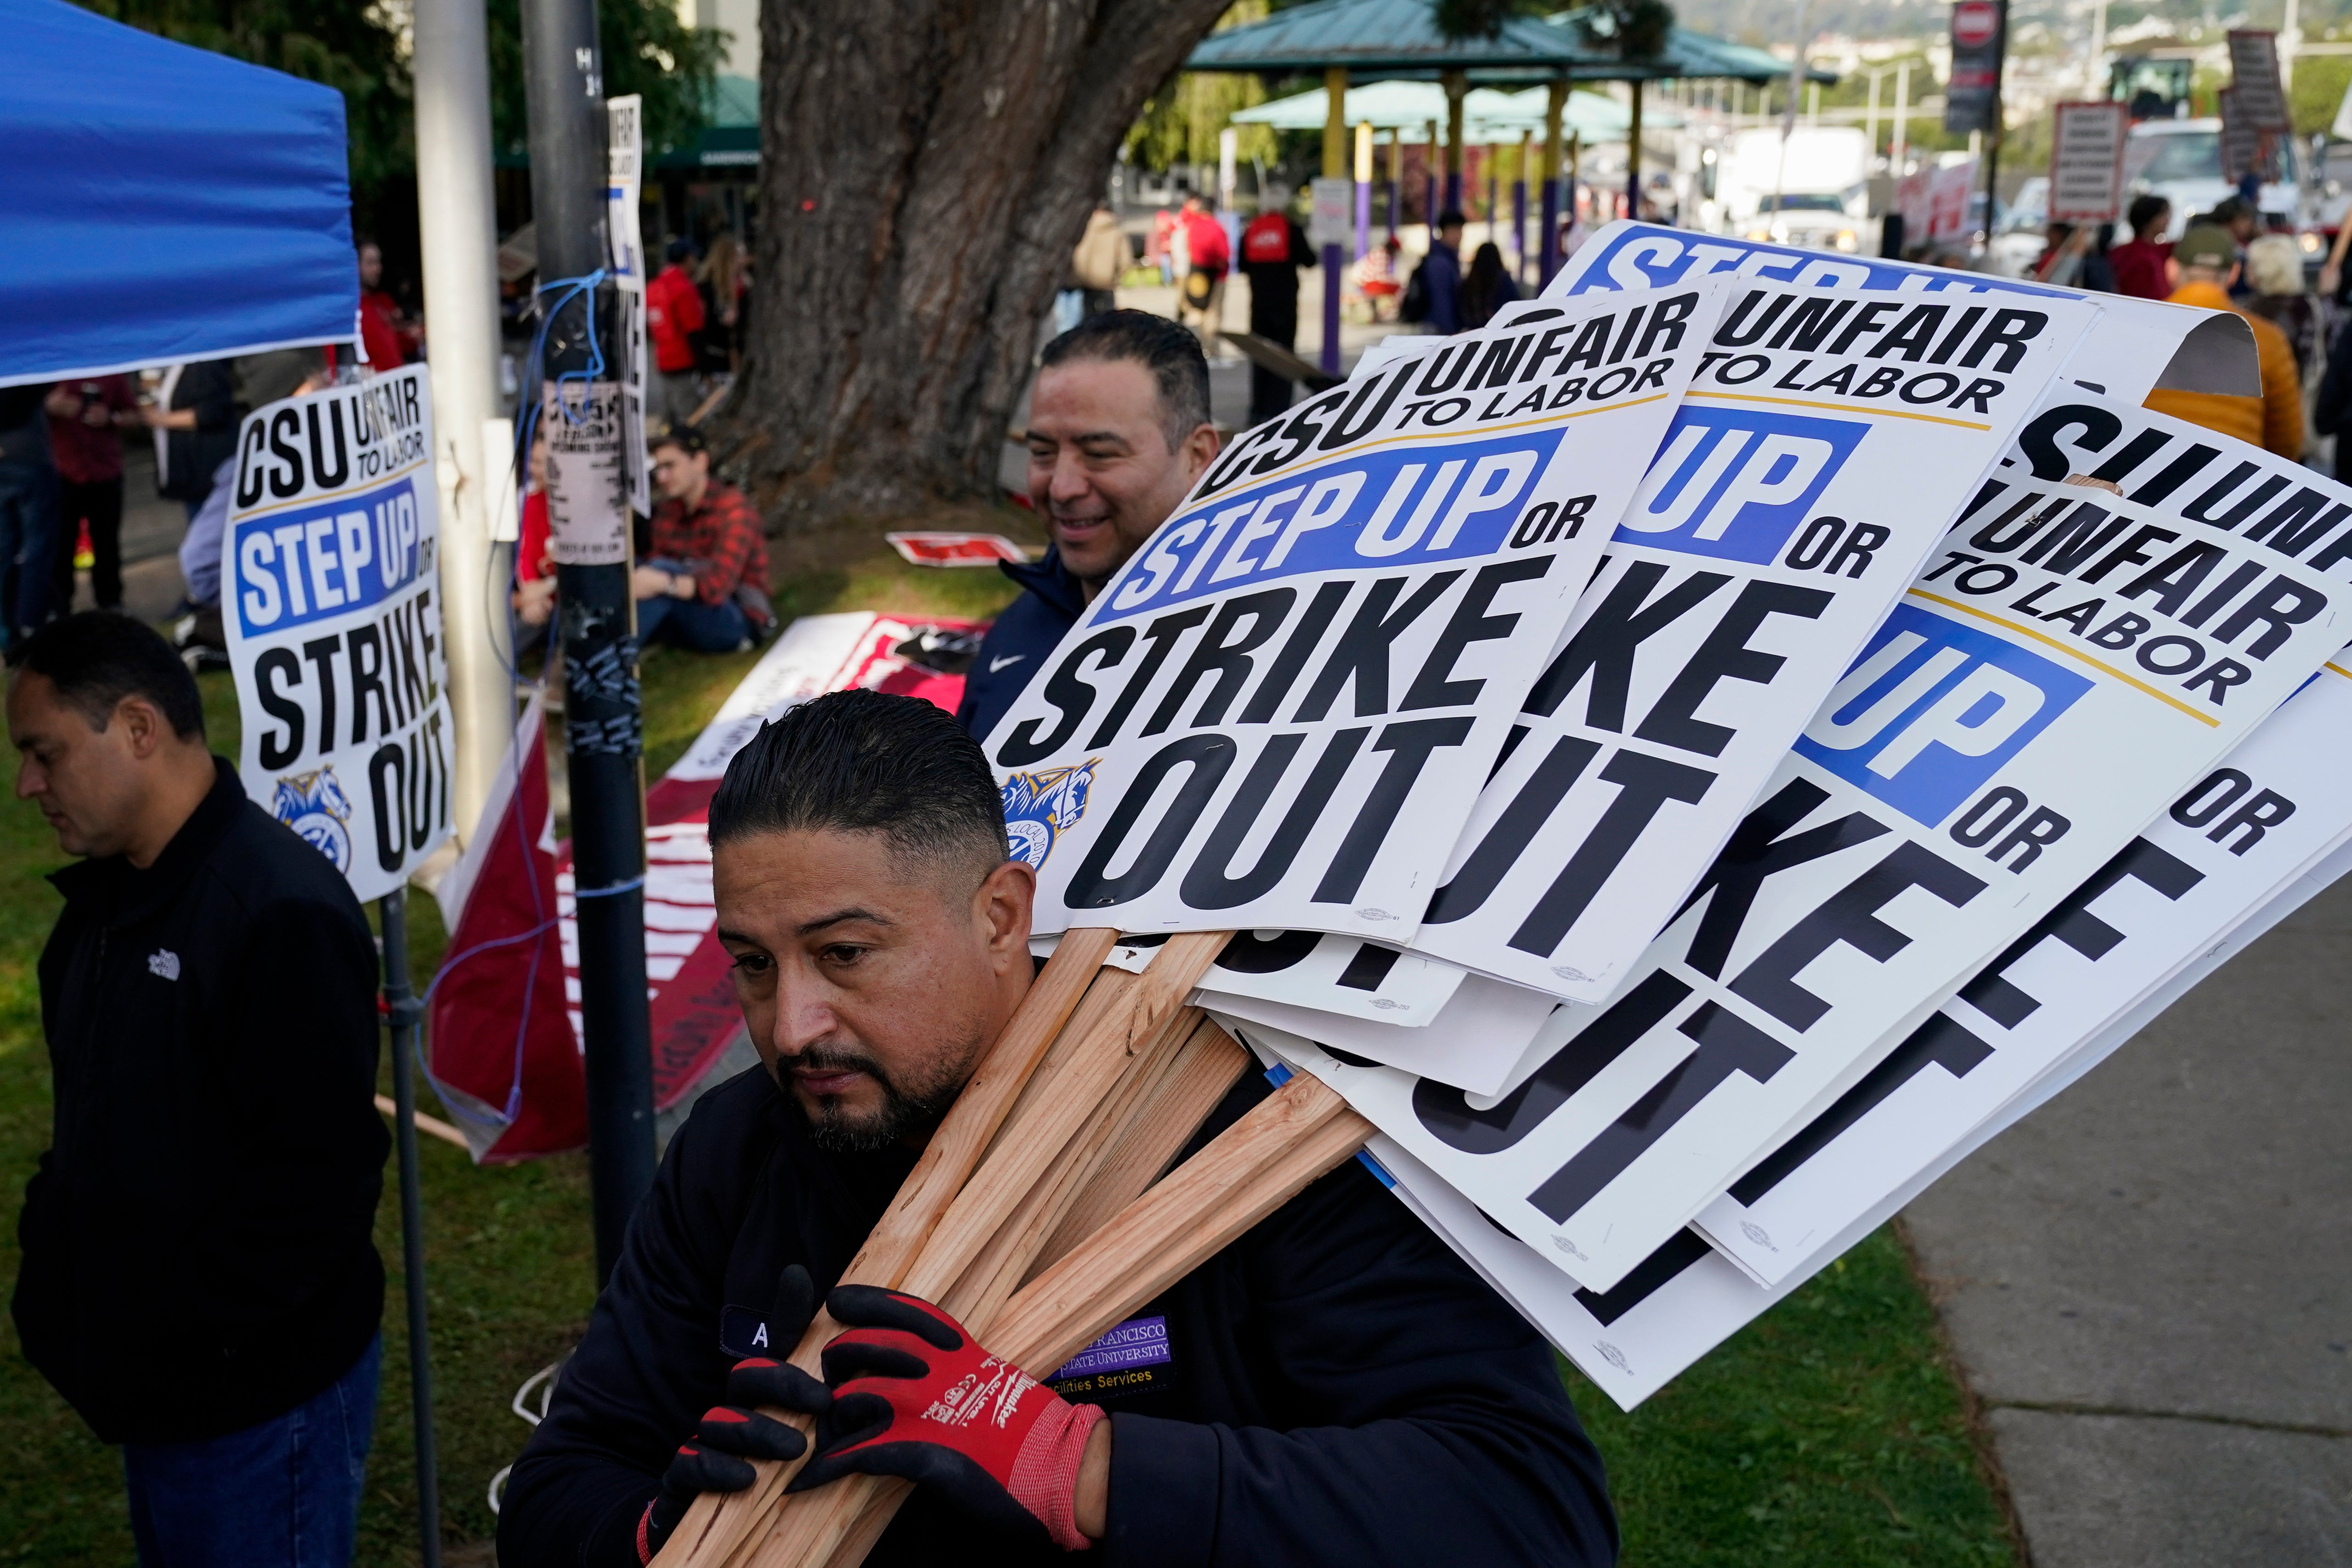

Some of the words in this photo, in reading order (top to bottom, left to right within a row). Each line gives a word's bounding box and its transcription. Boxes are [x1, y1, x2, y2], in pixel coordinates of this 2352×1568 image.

[1191, 358, 1422, 503] CSU
[1414, 292, 1699, 396] UNFAIR
[1395, 397, 1471, 430] TO
[1478, 357, 1674, 421] LABOR
[1692, 352, 1771, 385] TO
[1774, 359, 2005, 414] LABOR
[1713, 290, 2048, 374] UNFAIR
[237, 399, 349, 508] CSU
[357, 450, 380, 481] TO
[1618, 425, 1833, 543] UP
[1785, 516, 1891, 579] OR
[241, 513, 372, 627] STEP
[376, 492, 417, 590] UP
[1112, 470, 1367, 611] STEP
[1355, 449, 1539, 557] UP
[1510, 494, 1597, 549] OR
[1969, 492, 2328, 662] UNFAIR
[254, 589, 437, 772] STRIKE
[997, 555, 1557, 768] STRIKE
[1922, 551, 2018, 594] TO
[2009, 583, 2252, 706] LABOR
[368, 709, 448, 873] OUT
[1063, 716, 1476, 910] OUT
[1802, 630, 2045, 780] UP
[1949, 786, 2071, 875] OR
[2169, 767, 2296, 858] OR
[1014, 824, 1042, 842] LOCAL
[1029, 838, 1046, 863] 2010
[1048, 1379, 1092, 1394] cilities
[1098, 1370, 1152, 1388] Services
[1062, 1355, 1096, 1371] STATE
[1097, 1343, 1169, 1364] UNIVERSITY
